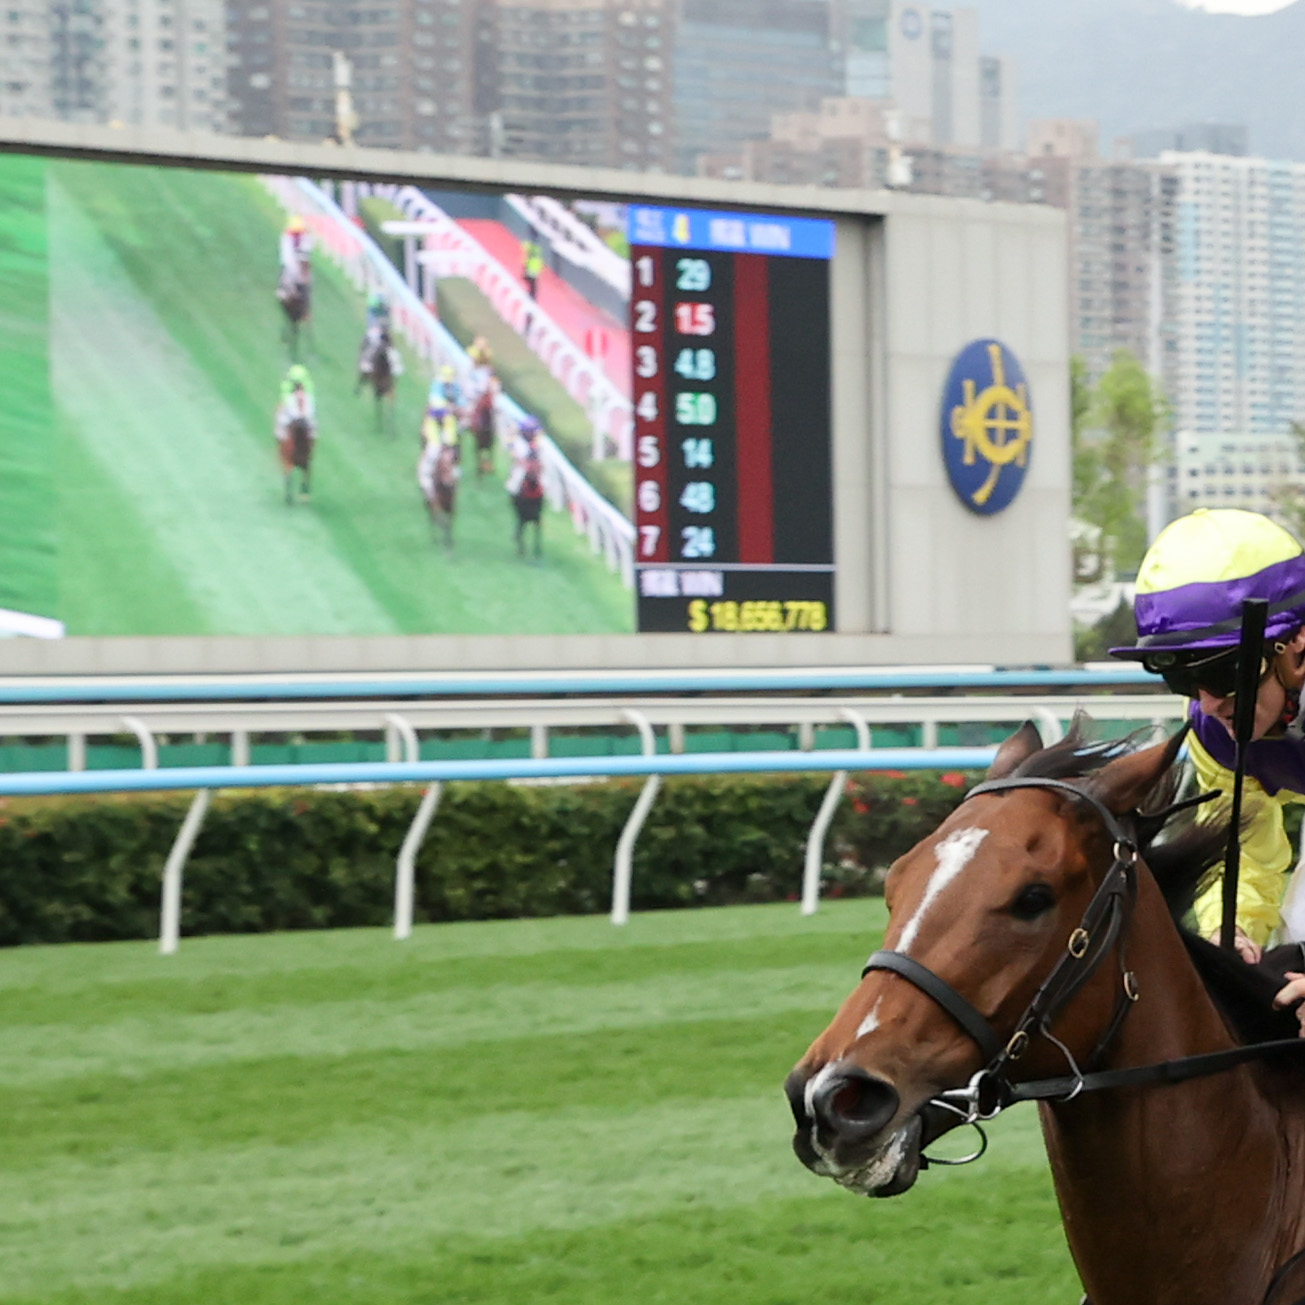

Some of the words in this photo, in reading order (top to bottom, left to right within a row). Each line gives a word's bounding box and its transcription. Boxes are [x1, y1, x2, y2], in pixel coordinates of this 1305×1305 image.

[635, 255, 654, 287] 1
[635, 300, 657, 333] 2
[636, 345, 658, 378] 3
[637, 391, 658, 422] 4
[637, 435, 660, 467] 5
[681, 438, 714, 468] 14
[638, 480, 661, 512] 6
[639, 525, 661, 556] 7
[681, 526, 715, 558] 24
